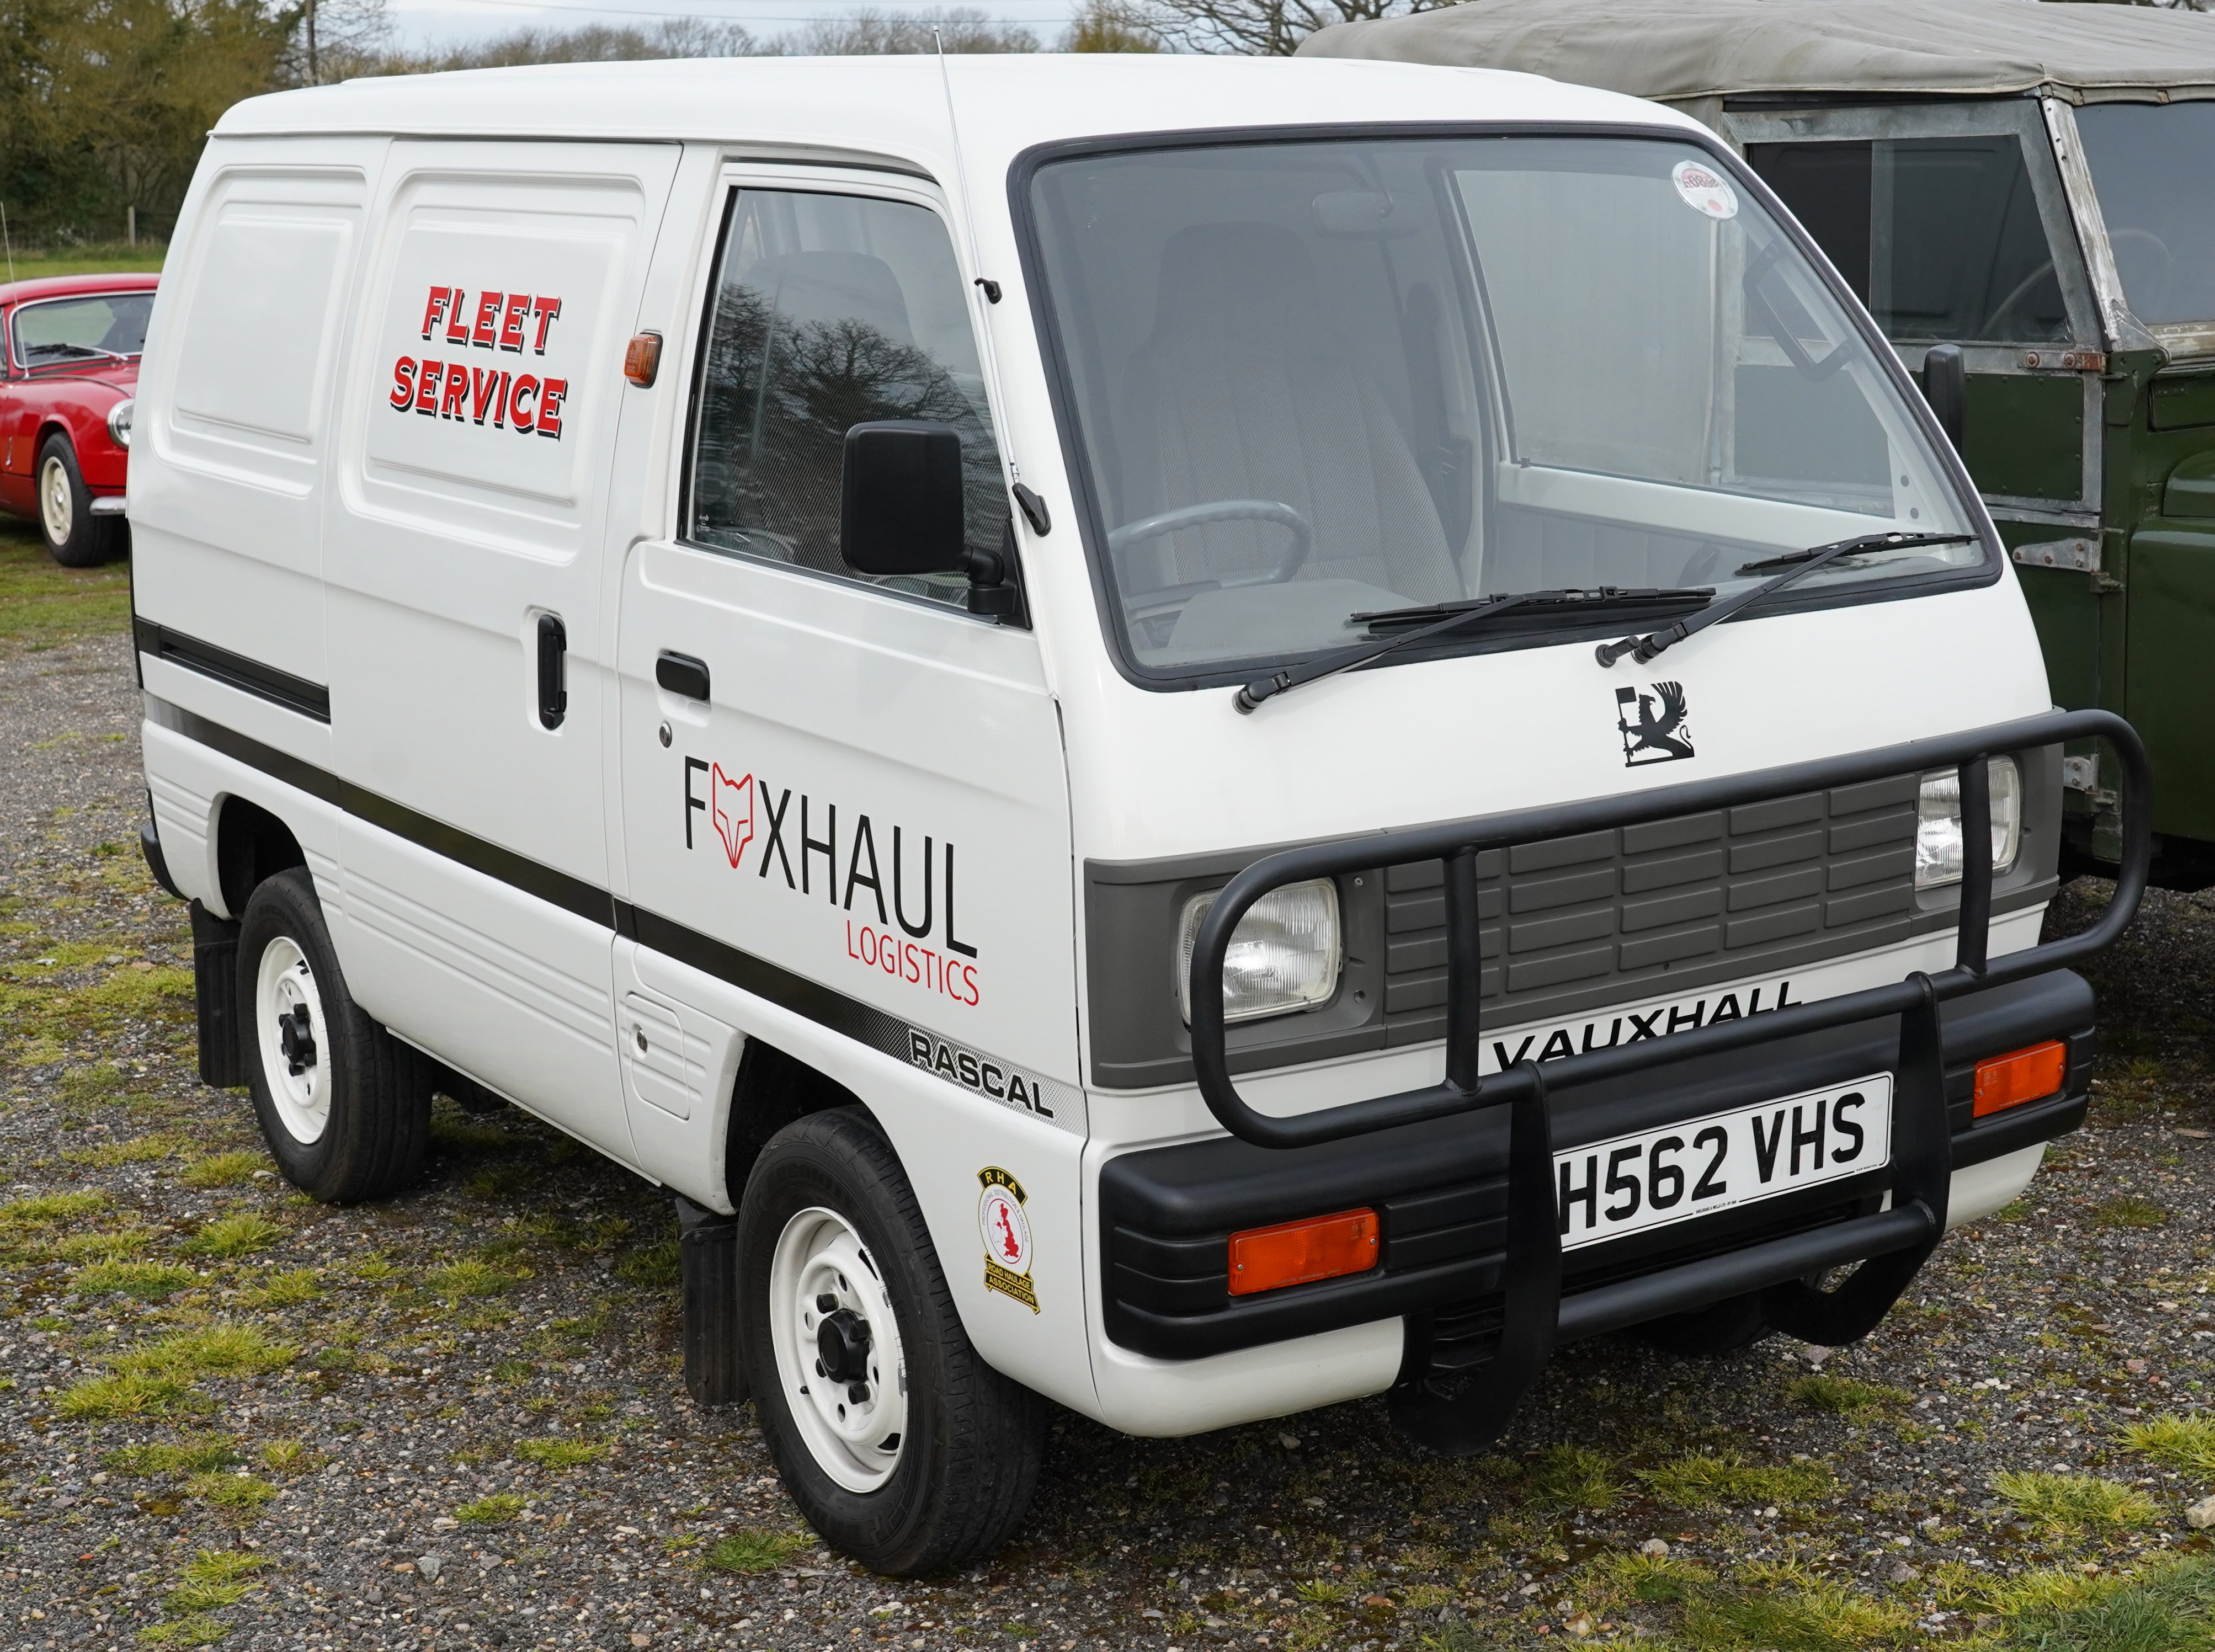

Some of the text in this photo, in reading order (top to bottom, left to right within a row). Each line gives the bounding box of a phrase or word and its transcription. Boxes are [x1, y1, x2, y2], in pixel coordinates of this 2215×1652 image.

[421, 285, 562, 356] FLEET
[390, 356, 568, 441] SERVICE
[847, 920, 979, 1006] LOGISTICS
[1493, 981, 1802, 1072] VAUXHALL
[911, 1032, 1053, 1118] RASCAL
[985, 1171, 1017, 1196] RHA
[1559, 1092, 1865, 1234] H562 VHS
[1019, 1214, 1029, 1243] HAULAGE
[988, 1263, 1031, 1291] ROAD HAULAGE
[989, 1276, 1035, 1304] ASSOCIATION
